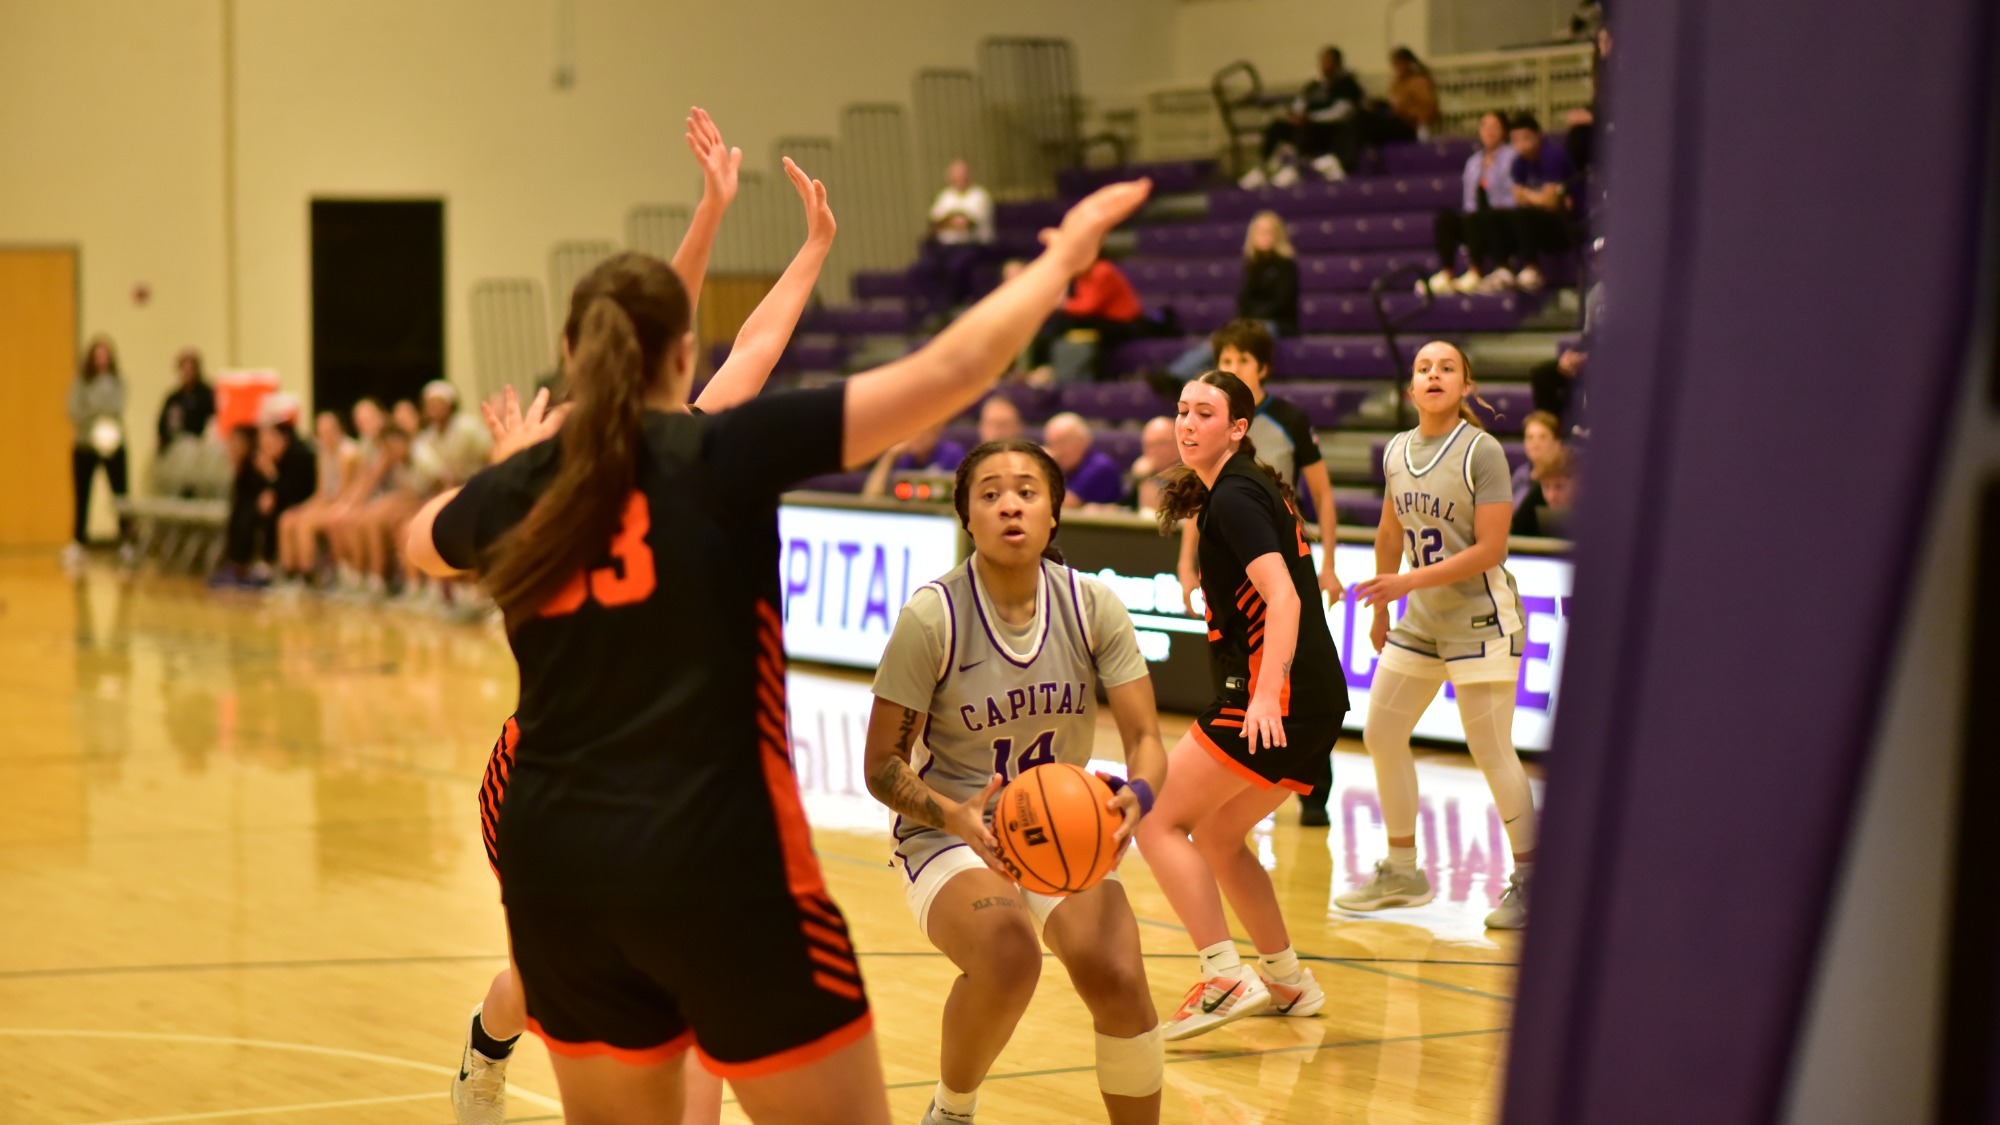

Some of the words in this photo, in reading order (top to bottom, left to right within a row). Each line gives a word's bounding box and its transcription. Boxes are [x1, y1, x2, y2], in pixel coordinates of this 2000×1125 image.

[537, 488, 658, 617] 3
[959, 682, 1087, 732] CAPITAL
[992, 730, 1056, 788] 14
